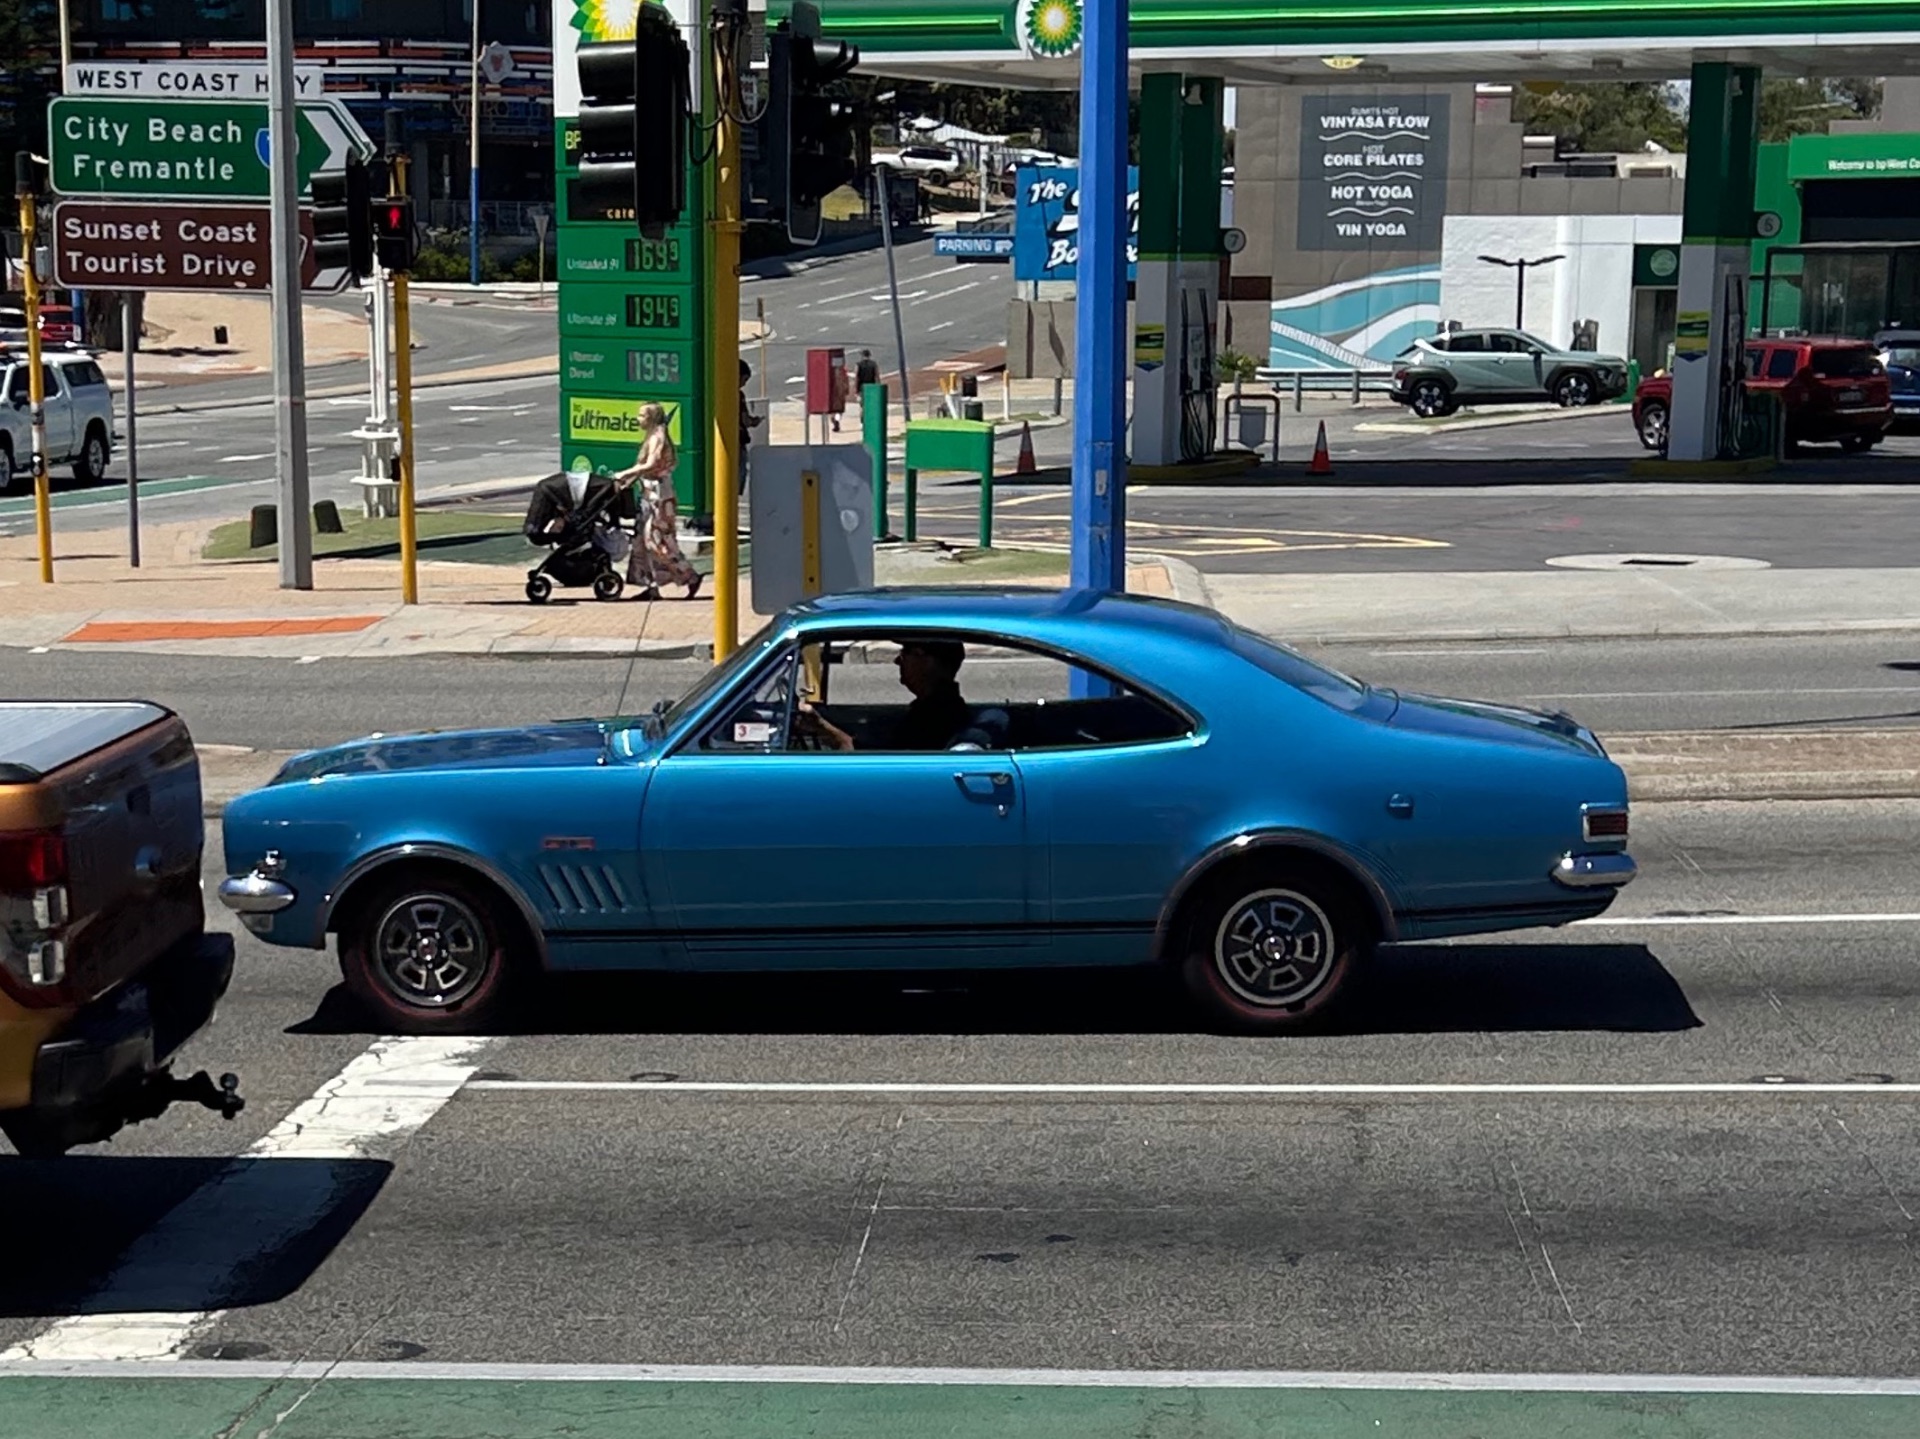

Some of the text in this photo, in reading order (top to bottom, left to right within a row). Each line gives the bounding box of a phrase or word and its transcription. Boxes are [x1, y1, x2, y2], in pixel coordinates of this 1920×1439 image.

[77, 70, 310, 94] WEST COAST HY
[64, 116, 242, 147] City Beach
[1321, 116, 1430, 128] VINYASA FLOW
[1323, 153, 1424, 166] CORE PILATES
[1362, 145, 1384, 154] HOT
[73, 154, 235, 180] Fremantle
[1030, 178, 1068, 203] The
[1331, 186, 1413, 199] HOT YOGA
[64, 217, 257, 243] Sunset Coast
[1336, 224, 1406, 236] YIN YOGA
[938, 239, 992, 252] PARKING
[66, 251, 256, 276] Tourist Drive
[573, 410, 639, 432] ultimate
